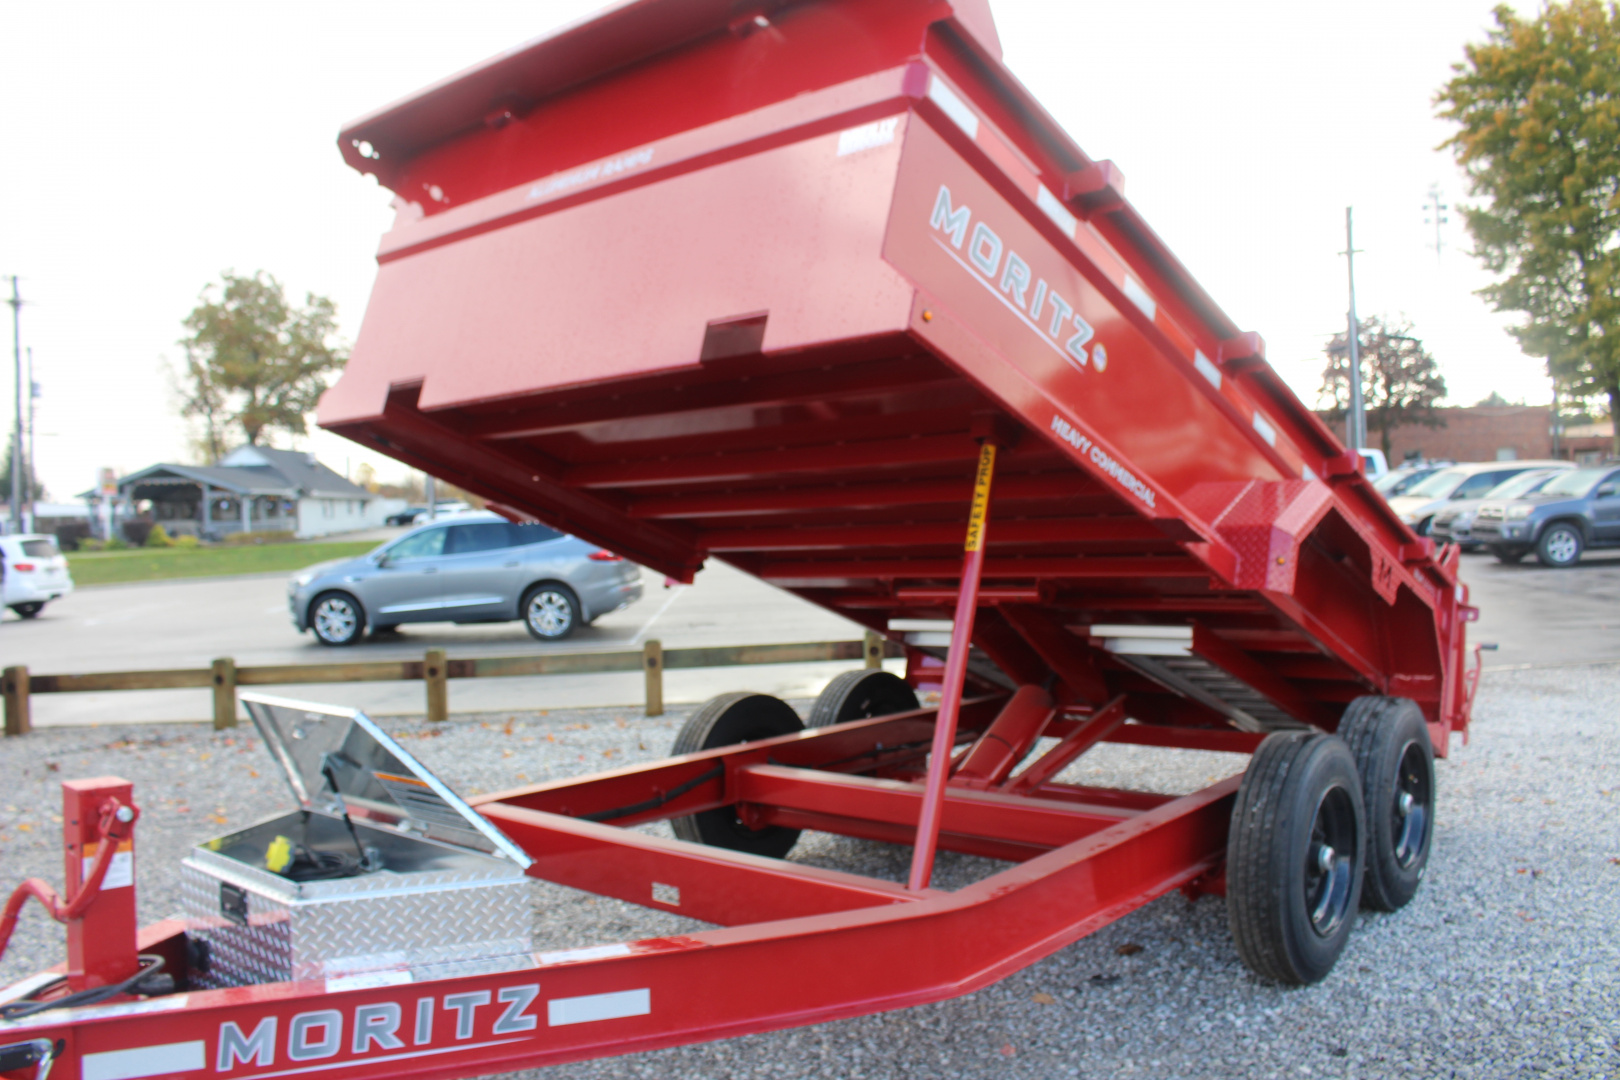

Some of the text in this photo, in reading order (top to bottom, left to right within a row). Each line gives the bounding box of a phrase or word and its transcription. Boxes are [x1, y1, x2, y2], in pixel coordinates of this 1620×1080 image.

[930, 184, 1094, 366] MORITZ
[967, 447, 993, 548] SAFETY PROP
[1050, 414, 1156, 508] HEAVY COMMERCIAL
[216, 984, 540, 1072] MORITZ
